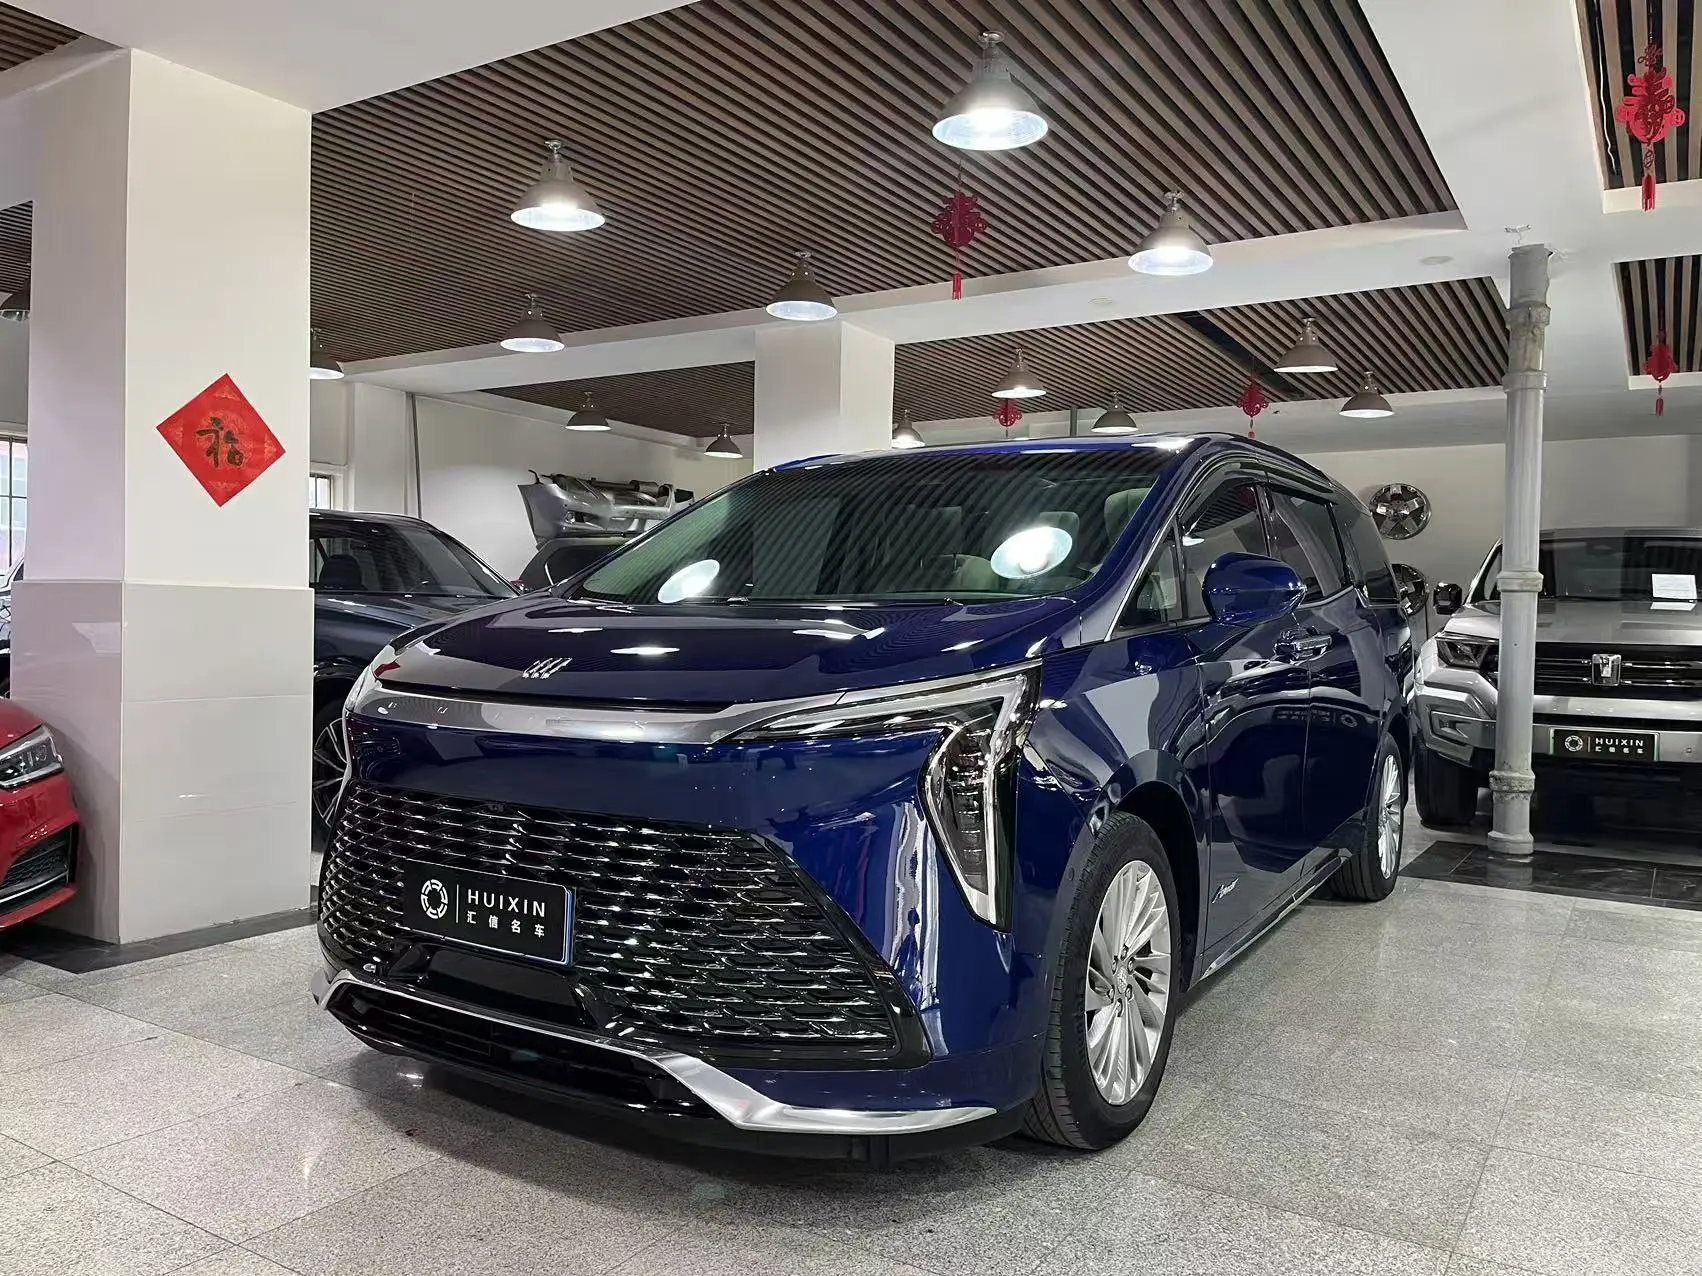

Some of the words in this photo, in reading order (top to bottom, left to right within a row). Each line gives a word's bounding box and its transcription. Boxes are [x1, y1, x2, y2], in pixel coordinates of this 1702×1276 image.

[196, 416, 244, 468] 福
[1595, 737, 1644, 747] HUIXIN
[467, 888, 545, 918] HUIXIN
[466, 910, 545, 938] 汇信名车
